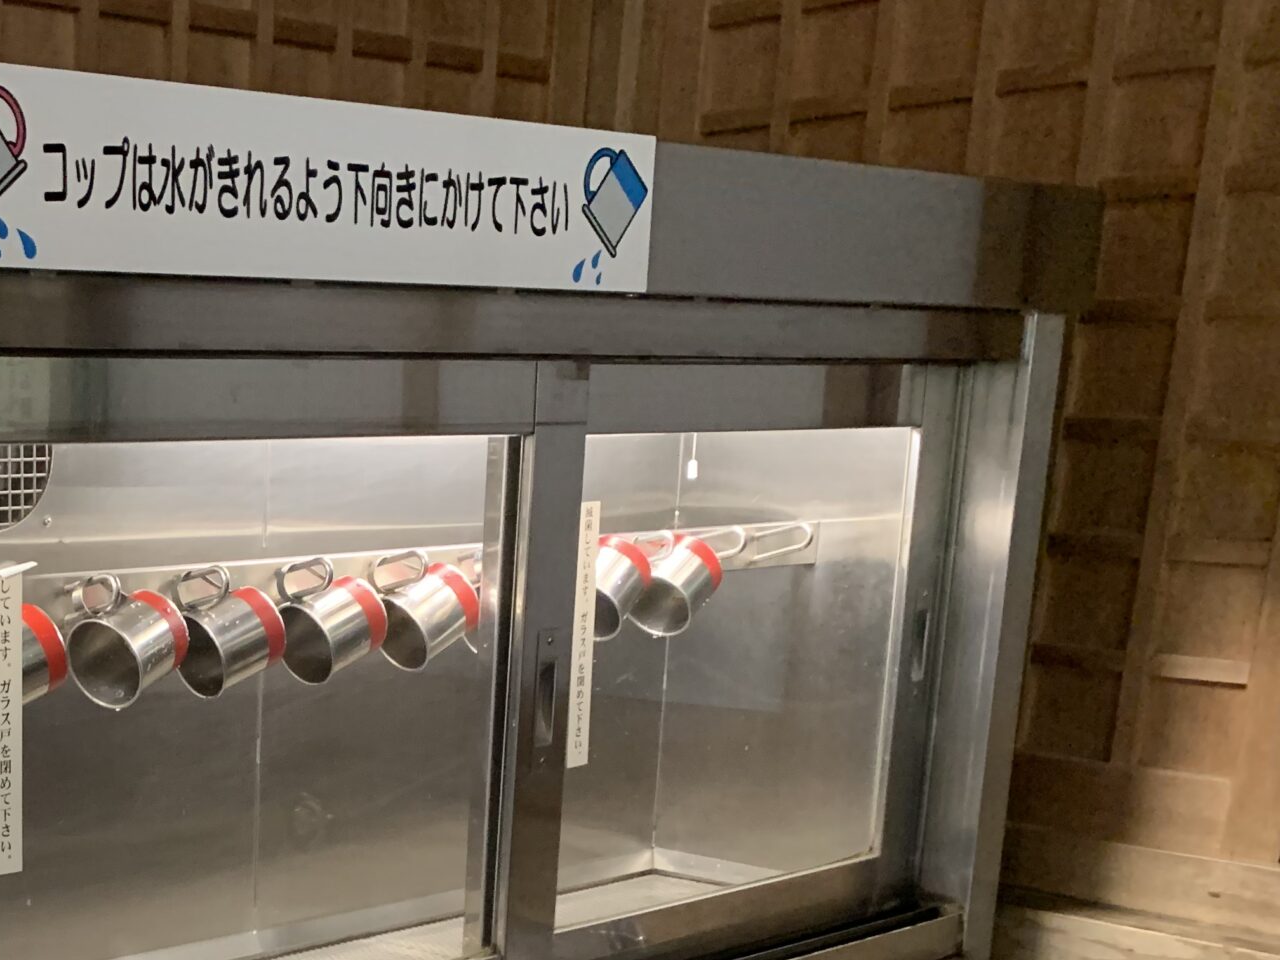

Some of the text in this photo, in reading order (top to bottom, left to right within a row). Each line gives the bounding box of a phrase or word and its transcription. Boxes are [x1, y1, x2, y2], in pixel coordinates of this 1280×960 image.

[42, 136, 570, 236] コップは水がきれるよう下向きにかけて下さい
